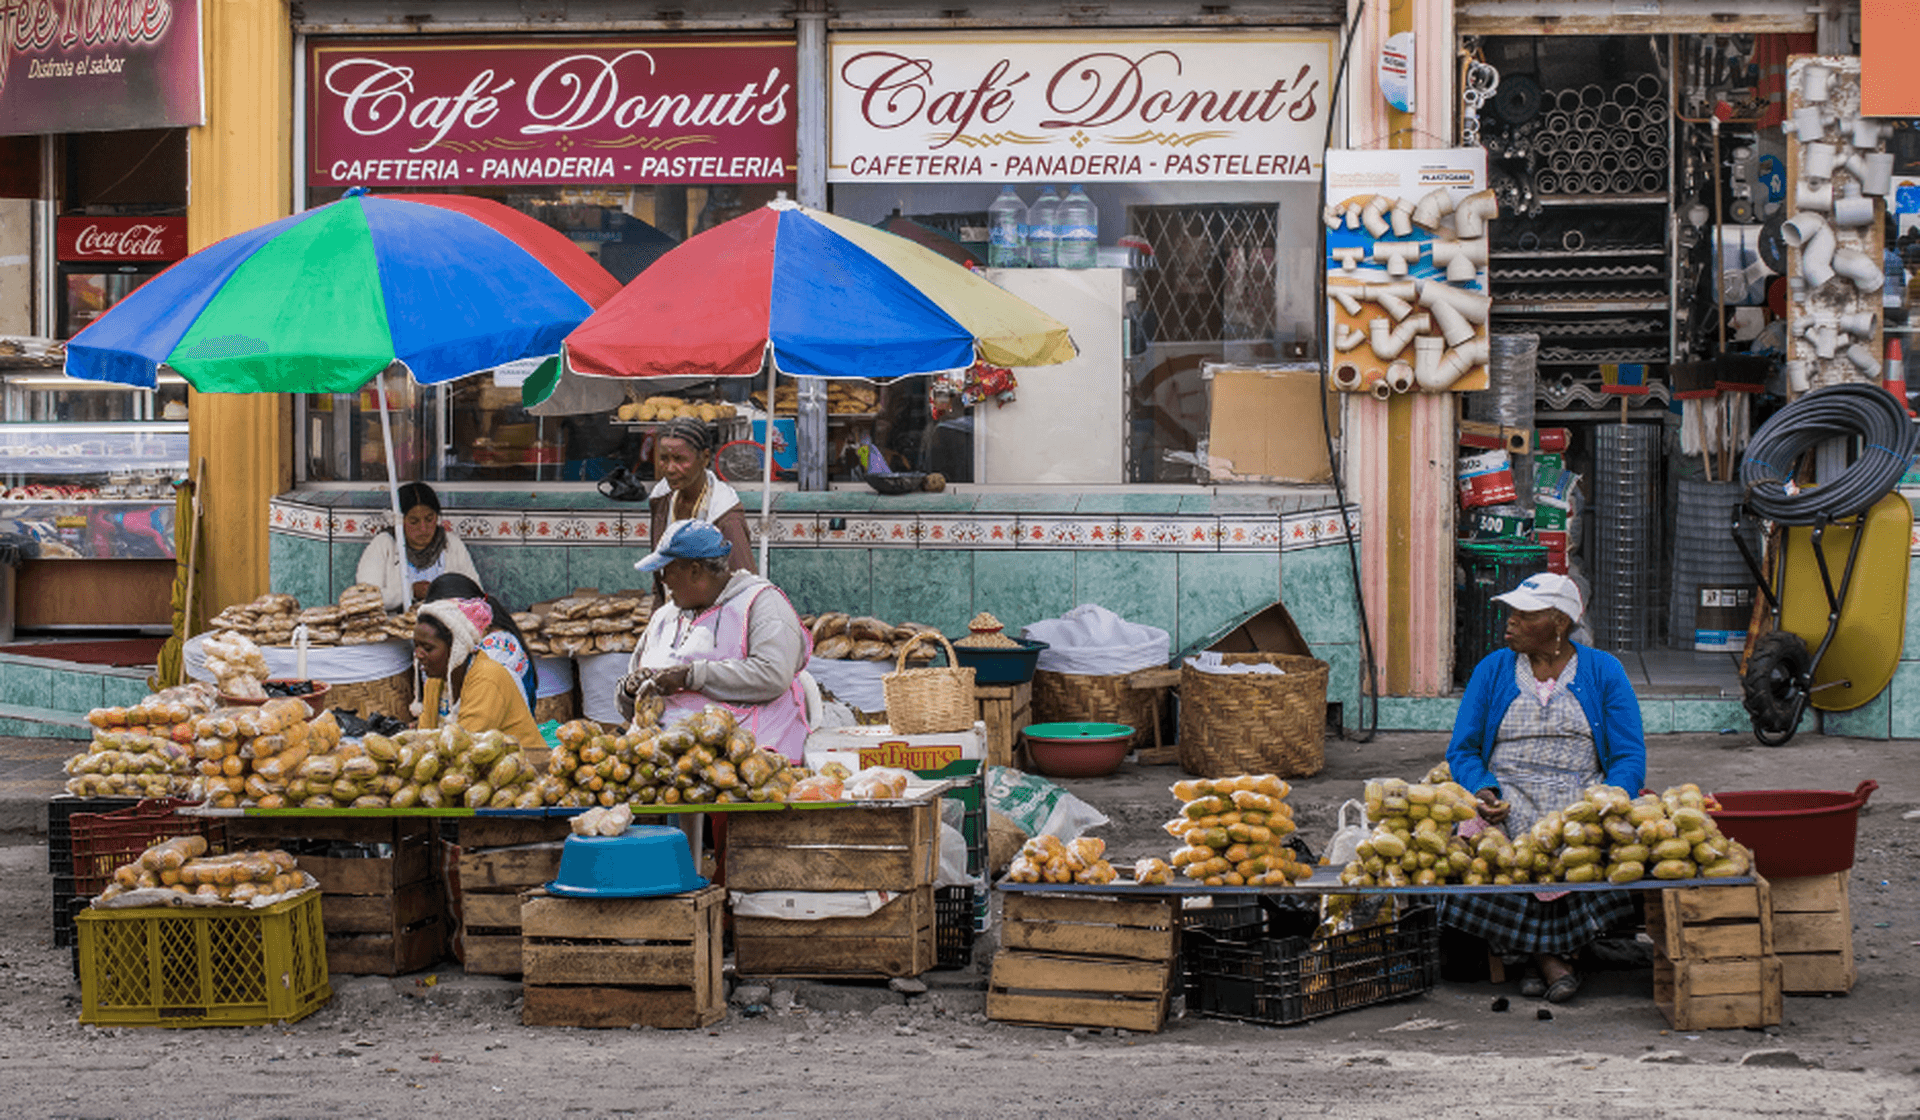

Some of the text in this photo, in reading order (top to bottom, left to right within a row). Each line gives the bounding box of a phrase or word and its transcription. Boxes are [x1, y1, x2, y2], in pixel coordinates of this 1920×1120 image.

[28, 53, 126, 79] Disfruta el sabor
[325, 49, 790, 153] Café Donut's
[841, 50, 1319, 150] Café Donut's
[330, 159, 460, 181] CAFETERIA
[481, 157, 615, 179] PANADERIA
[640, 156, 785, 178] PASTELERIA
[850, 155, 983, 176] CAFETERIA
[1004, 154, 1142, 177] PANADERIA
[1164, 154, 1311, 175] PASTELERIA
[75, 224, 167, 256] Coca-Cola
